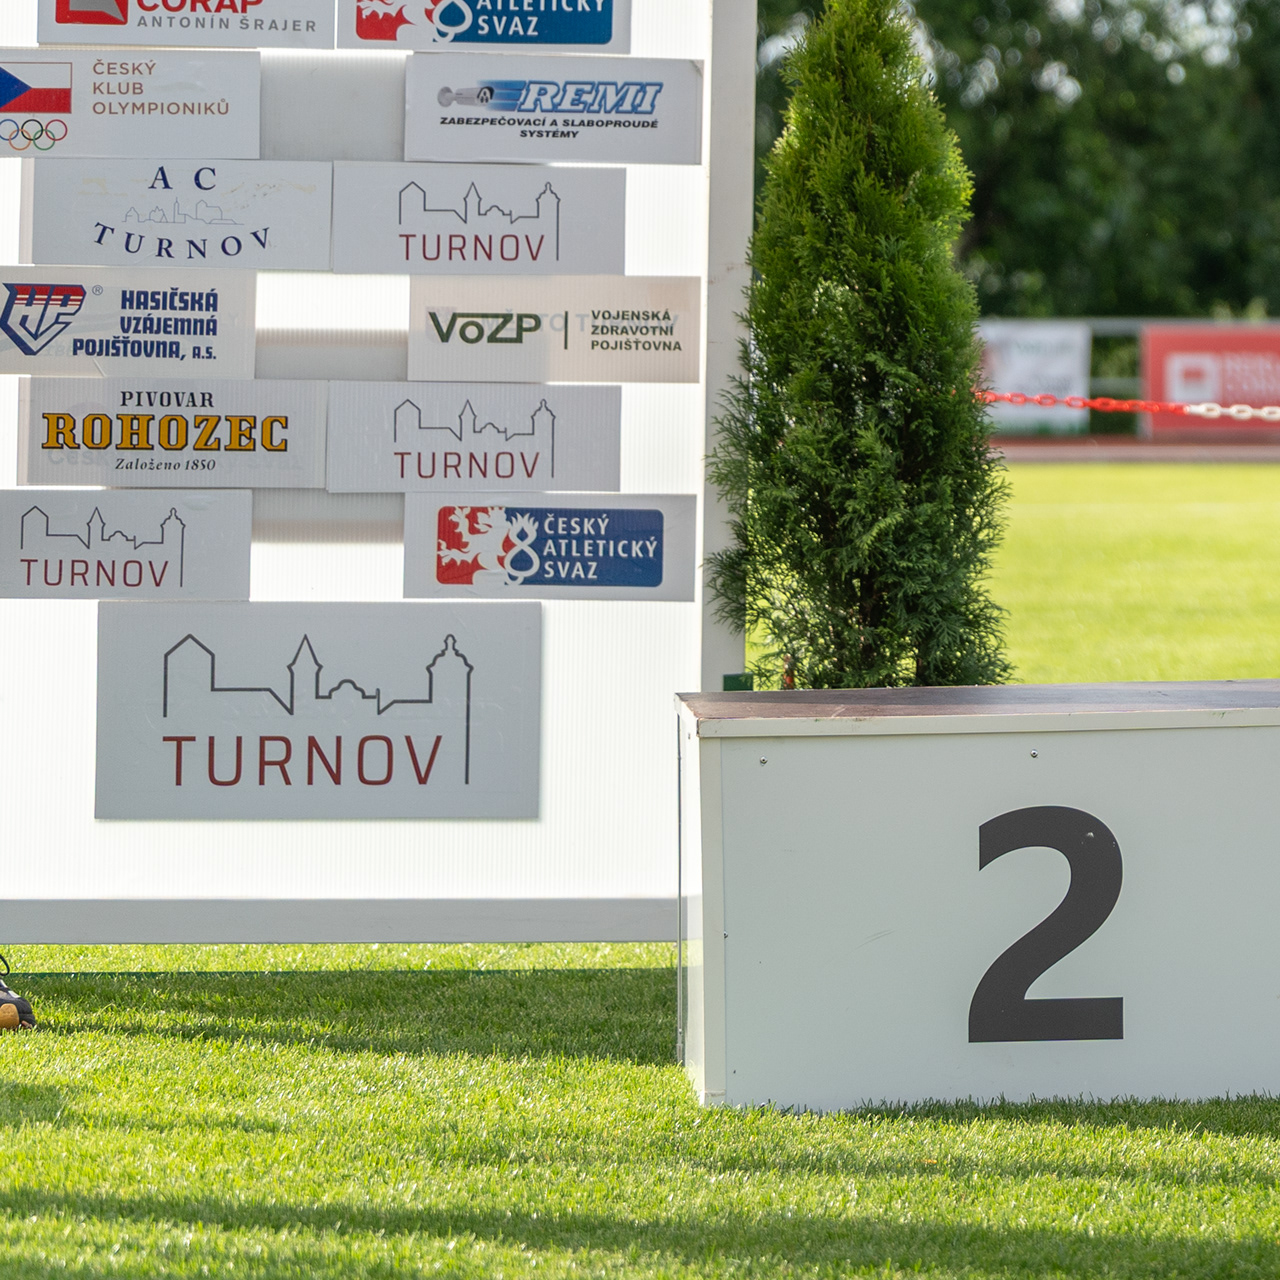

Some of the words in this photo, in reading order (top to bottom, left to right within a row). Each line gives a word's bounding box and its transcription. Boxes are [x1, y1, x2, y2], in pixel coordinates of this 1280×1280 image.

[137, 14, 232, 31] ANTONÍN
[238, 15, 317, 33] ŠRAJER
[476, 16, 538, 36] SVAZ
[92, 59, 156, 76] ČESKÝ
[92, 81, 144, 96] KLUB
[516, 79, 664, 115] REMI
[92, 97, 230, 117] OLYMPIONIKŮ
[439, 115, 546, 127] ZABEZPEČOVACÍ
[549, 118, 558, 128] A
[562, 117, 658, 130] SLABOPROUDÉ
[519, 128, 578, 140] SYSTÉMY
[93, 222, 271, 260] TURNOV
[399, 234, 546, 262] TURNOV
[120, 288, 218, 312] HASIČSKÁ
[119, 313, 218, 336] VZÁJEMNÁ
[591, 309, 671, 321] VOJENSKÁ
[590, 323, 673, 337] ZDRAVOTNÍ
[590, 336, 682, 352] POJIŠŤOVNA
[120, 391, 214, 407] PIVOVAR
[42, 413, 288, 451] ROHOZEC
[115, 457, 181, 473] Založeno
[184, 459, 215, 472] 1850
[394, 452, 540, 479] TURNOV
[543, 513, 610, 535] ČESKÝ
[543, 535, 658, 558] ATLETICKÝ
[20, 559, 169, 588] TURNOV
[543, 561, 598, 579] SVAZ
[162, 734, 443, 787] TURNOV
[968, 805, 1127, 1043] 2
